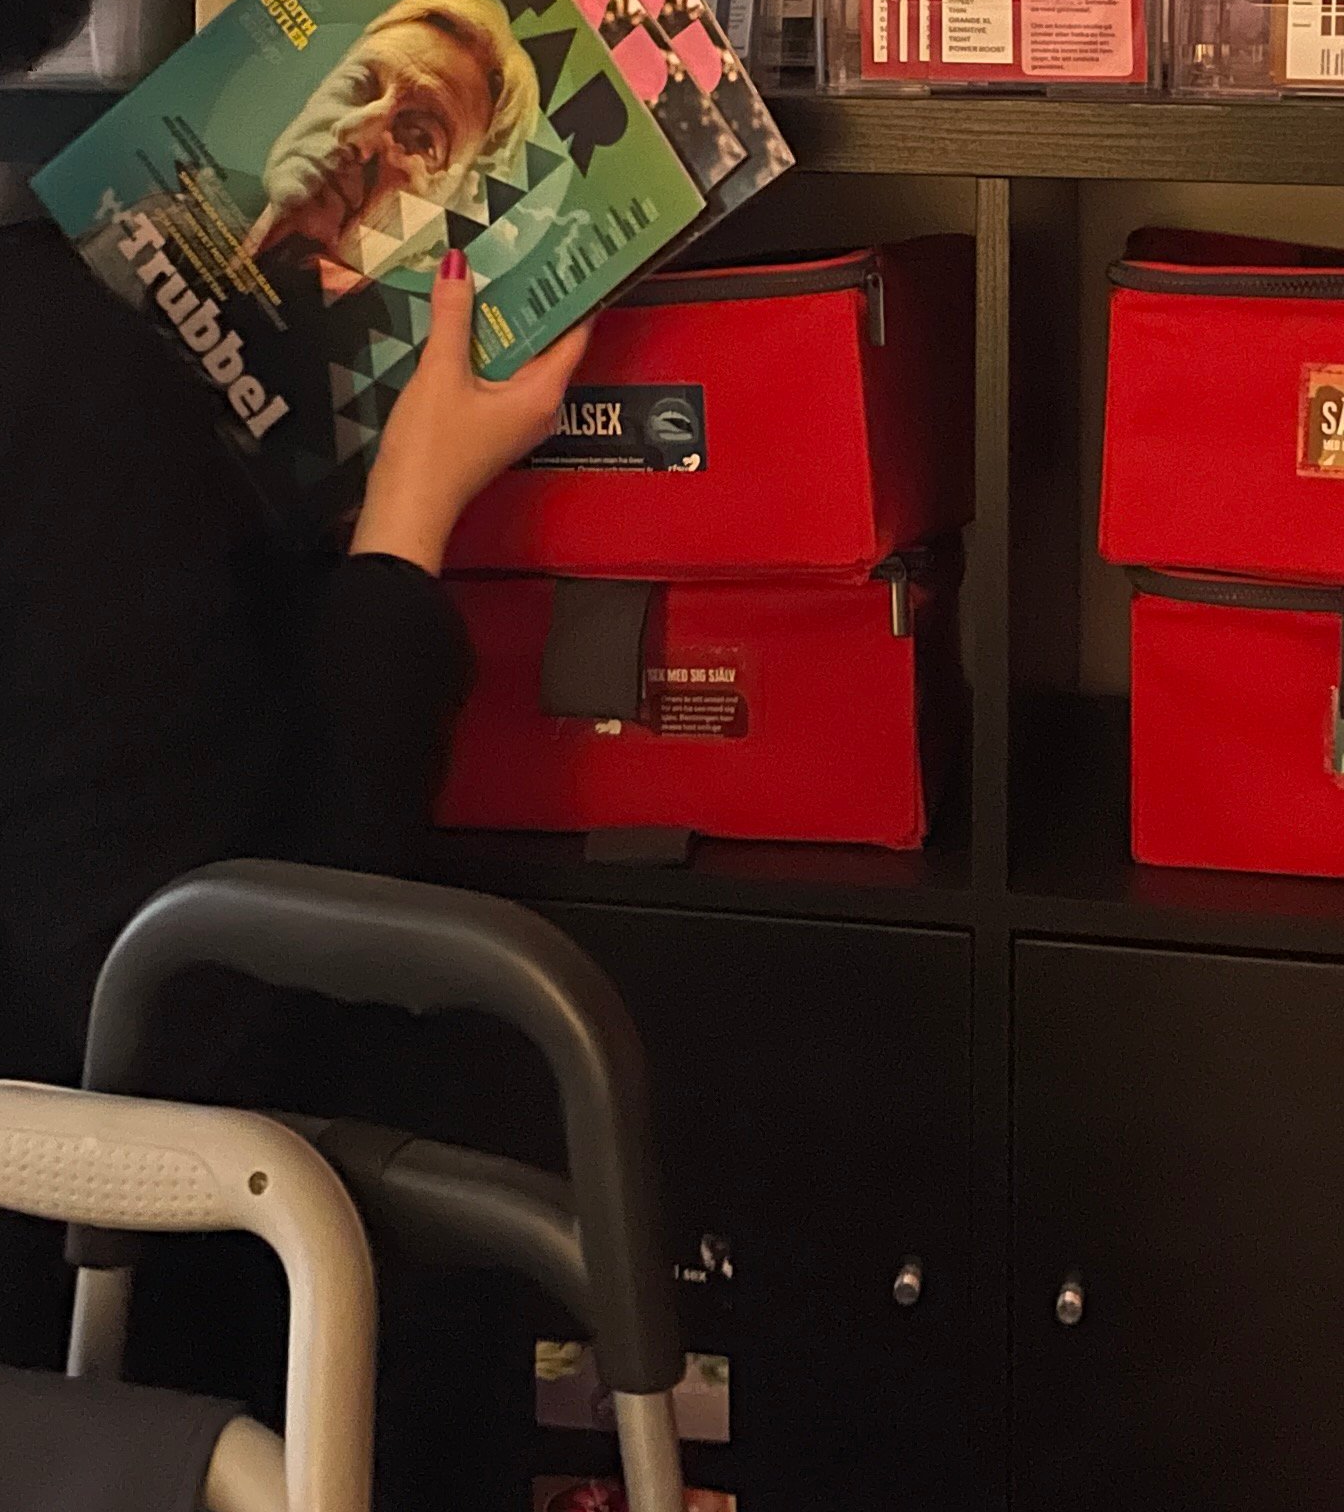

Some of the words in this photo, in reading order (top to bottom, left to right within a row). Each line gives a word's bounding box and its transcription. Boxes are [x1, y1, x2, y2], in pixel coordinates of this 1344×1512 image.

[117, 211, 290, 439] Trubbel
[556, 402, 622, 437] ALSEX
[667, 669, 688, 682] MED
[690, 669, 706, 682] SIG
